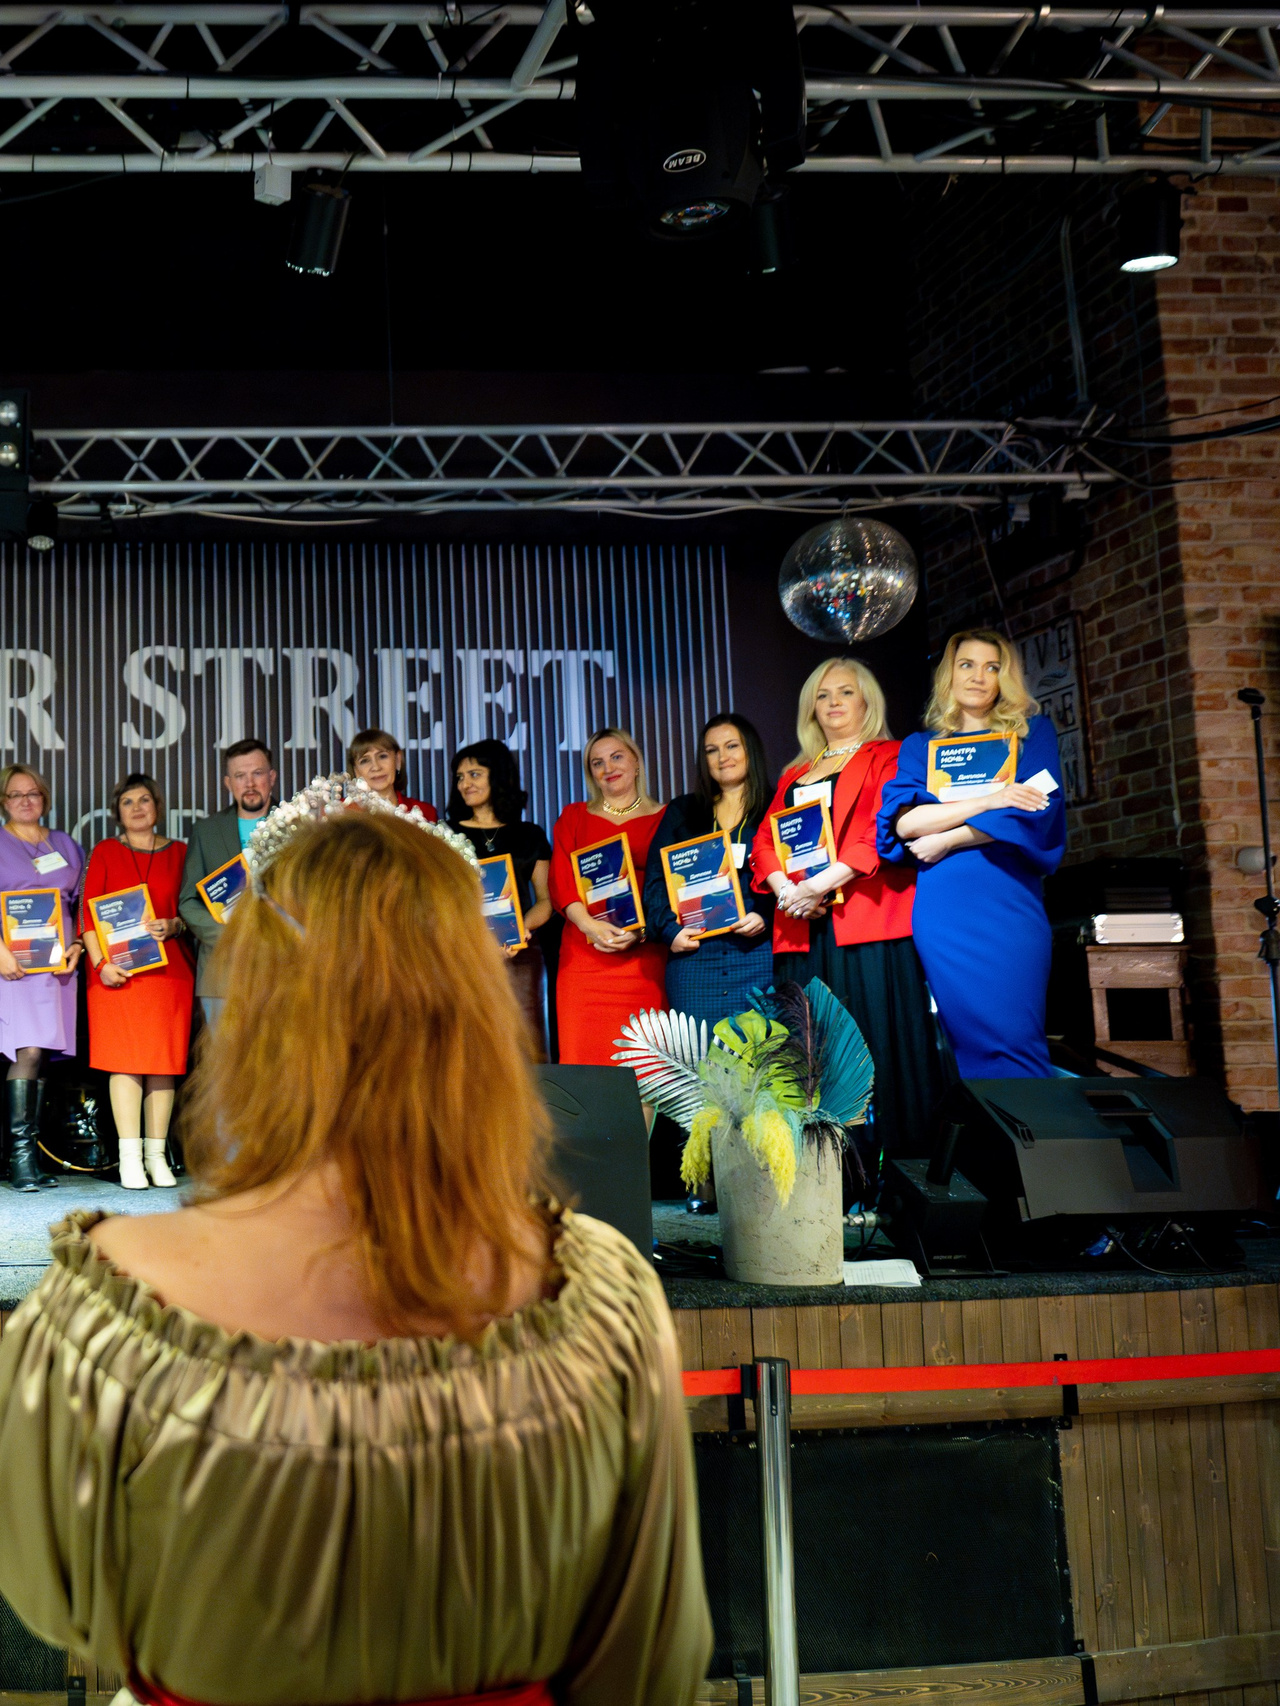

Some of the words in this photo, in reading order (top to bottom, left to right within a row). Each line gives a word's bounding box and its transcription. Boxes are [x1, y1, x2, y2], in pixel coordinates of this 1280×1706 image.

[668, 153, 701, 168] BEAM
[1021, 625, 1072, 676] IVE
[122, 645, 615, 750] STREET
[941, 747, 976, 756] МАНТРА
[941, 755, 964, 763] НОЧЬ
[957, 772, 986, 781] Диплом
